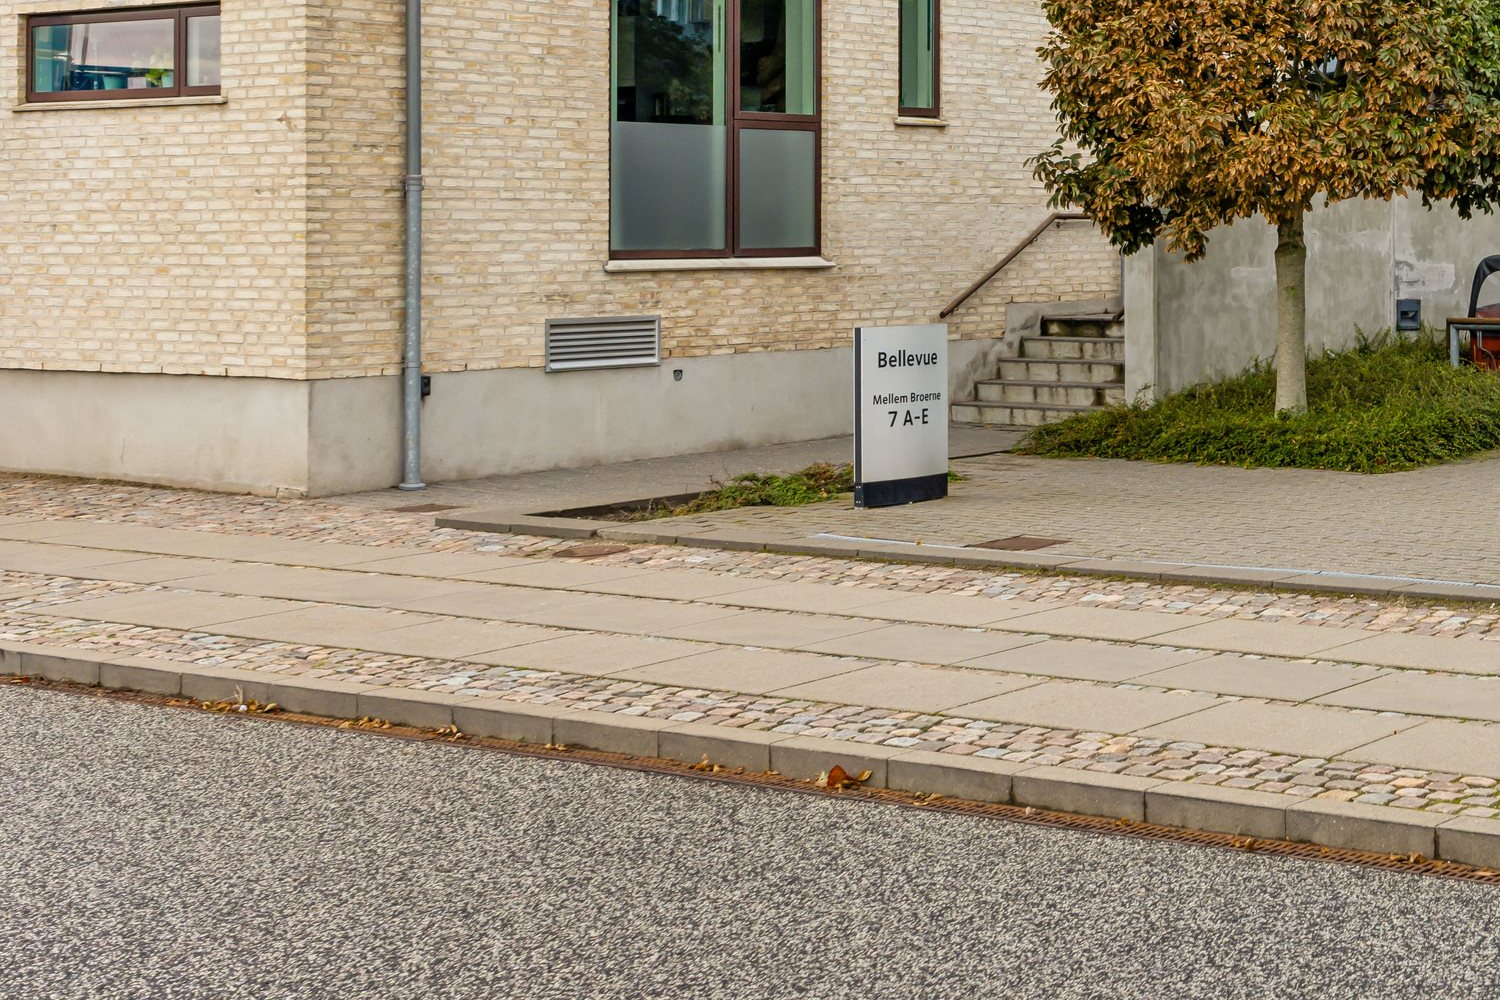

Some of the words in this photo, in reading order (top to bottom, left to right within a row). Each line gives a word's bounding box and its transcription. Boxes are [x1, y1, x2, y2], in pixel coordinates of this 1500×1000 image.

[878, 349, 938, 368] Bellevue
[872, 393, 908, 406] Mellem
[910, 392, 941, 403] Broerne
[888, 410, 898, 428] 7
[903, 408, 929, 427] A-E
